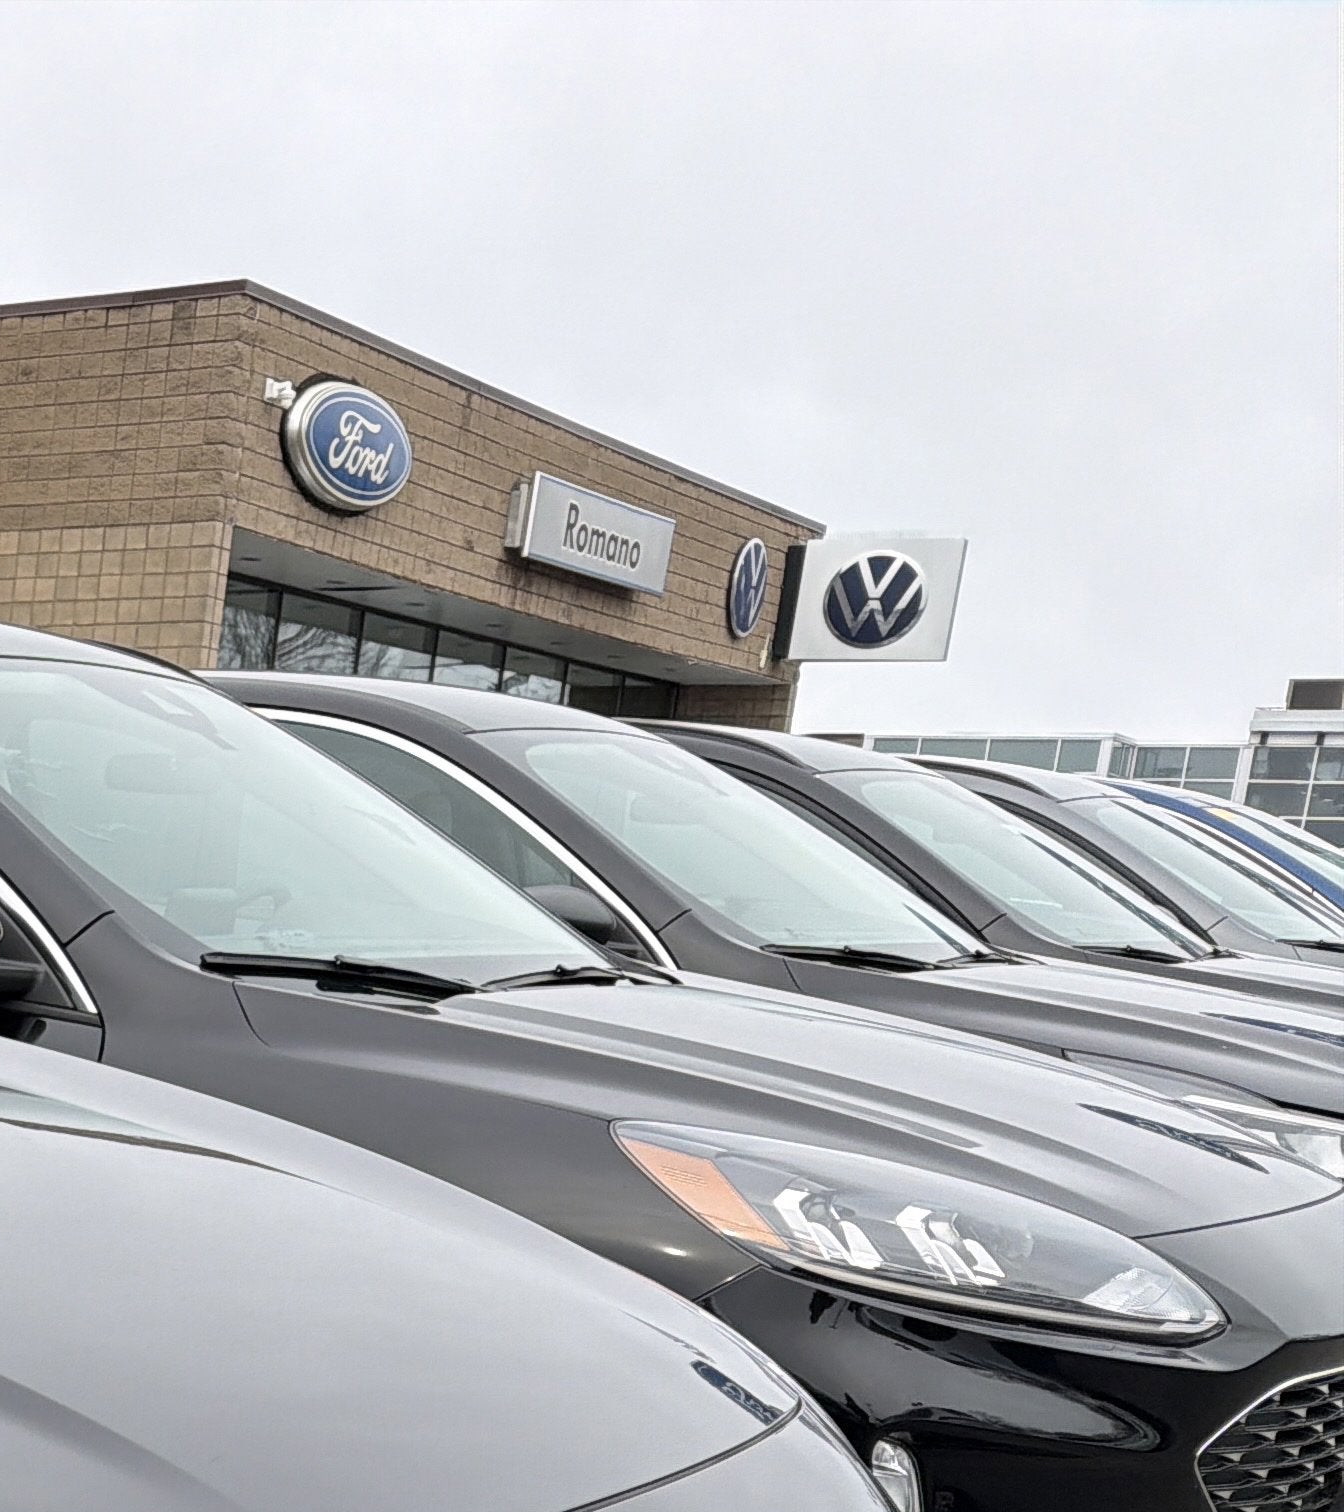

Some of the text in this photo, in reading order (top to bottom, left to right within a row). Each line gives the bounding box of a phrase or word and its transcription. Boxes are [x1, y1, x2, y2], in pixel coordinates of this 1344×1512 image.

[328, 410, 394, 485] Ford
[563, 502, 641, 570] Romano
[829, 553, 924, 639] VW
